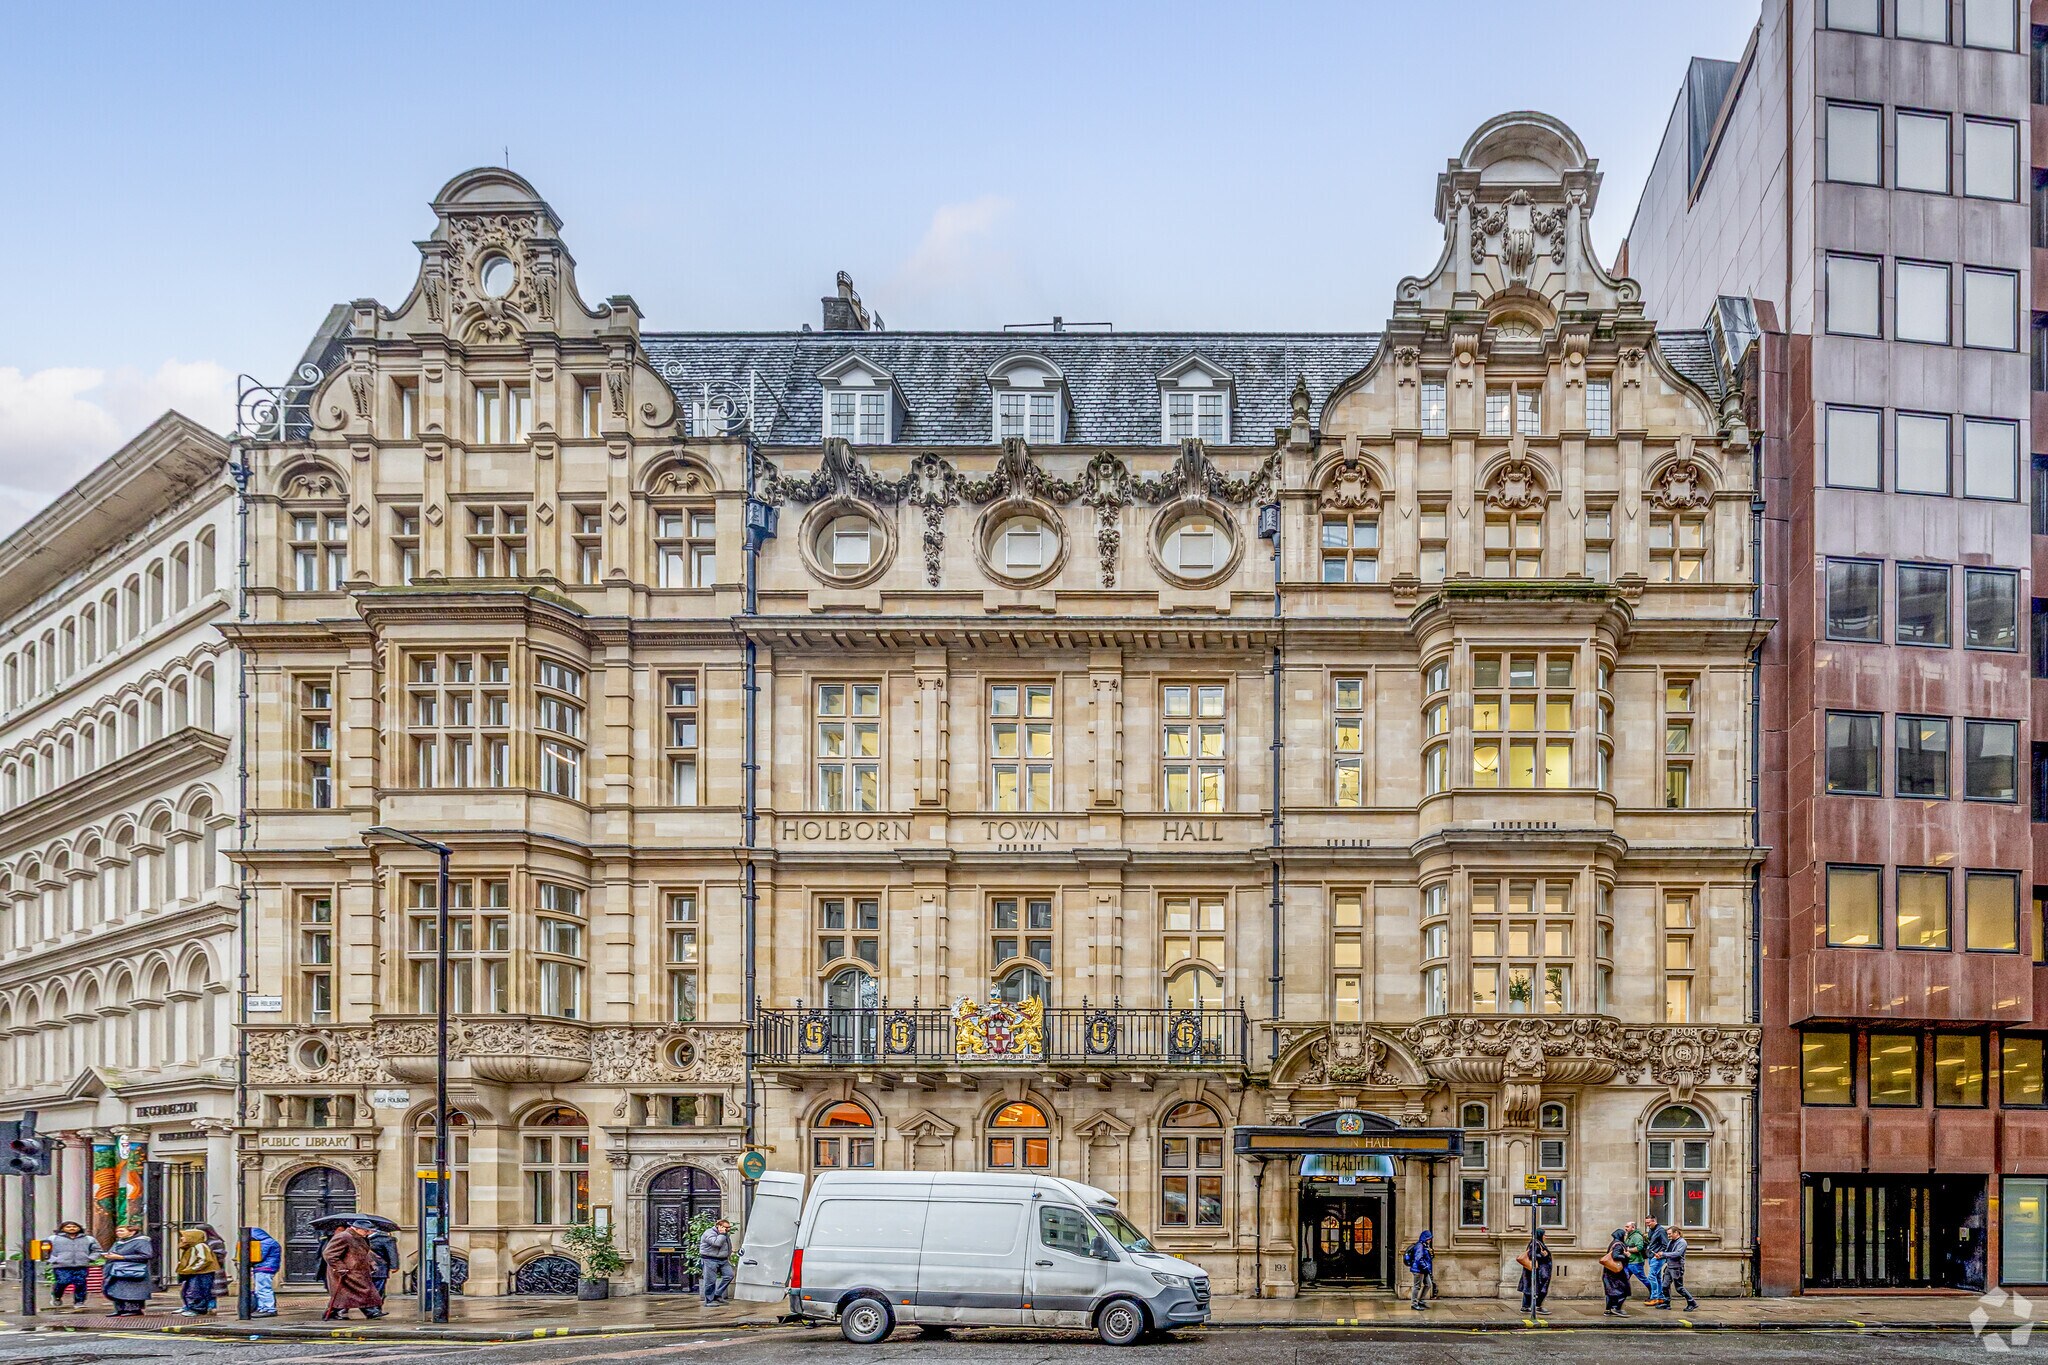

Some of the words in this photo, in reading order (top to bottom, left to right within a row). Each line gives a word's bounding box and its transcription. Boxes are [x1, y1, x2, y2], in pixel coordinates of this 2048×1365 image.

[782, 821, 911, 840] HOLBORN
[981, 821, 1059, 840] TOWN
[1163, 821, 1223, 841] HALL
[1672, 1028, 1697, 1037] 1908
[261, 1137, 300, 1147] PUBLIC
[305, 1137, 349, 1147] LIBRARY
[1365, 1137, 1392, 1148] HALL
[1331, 1161, 1364, 1171] HALL
